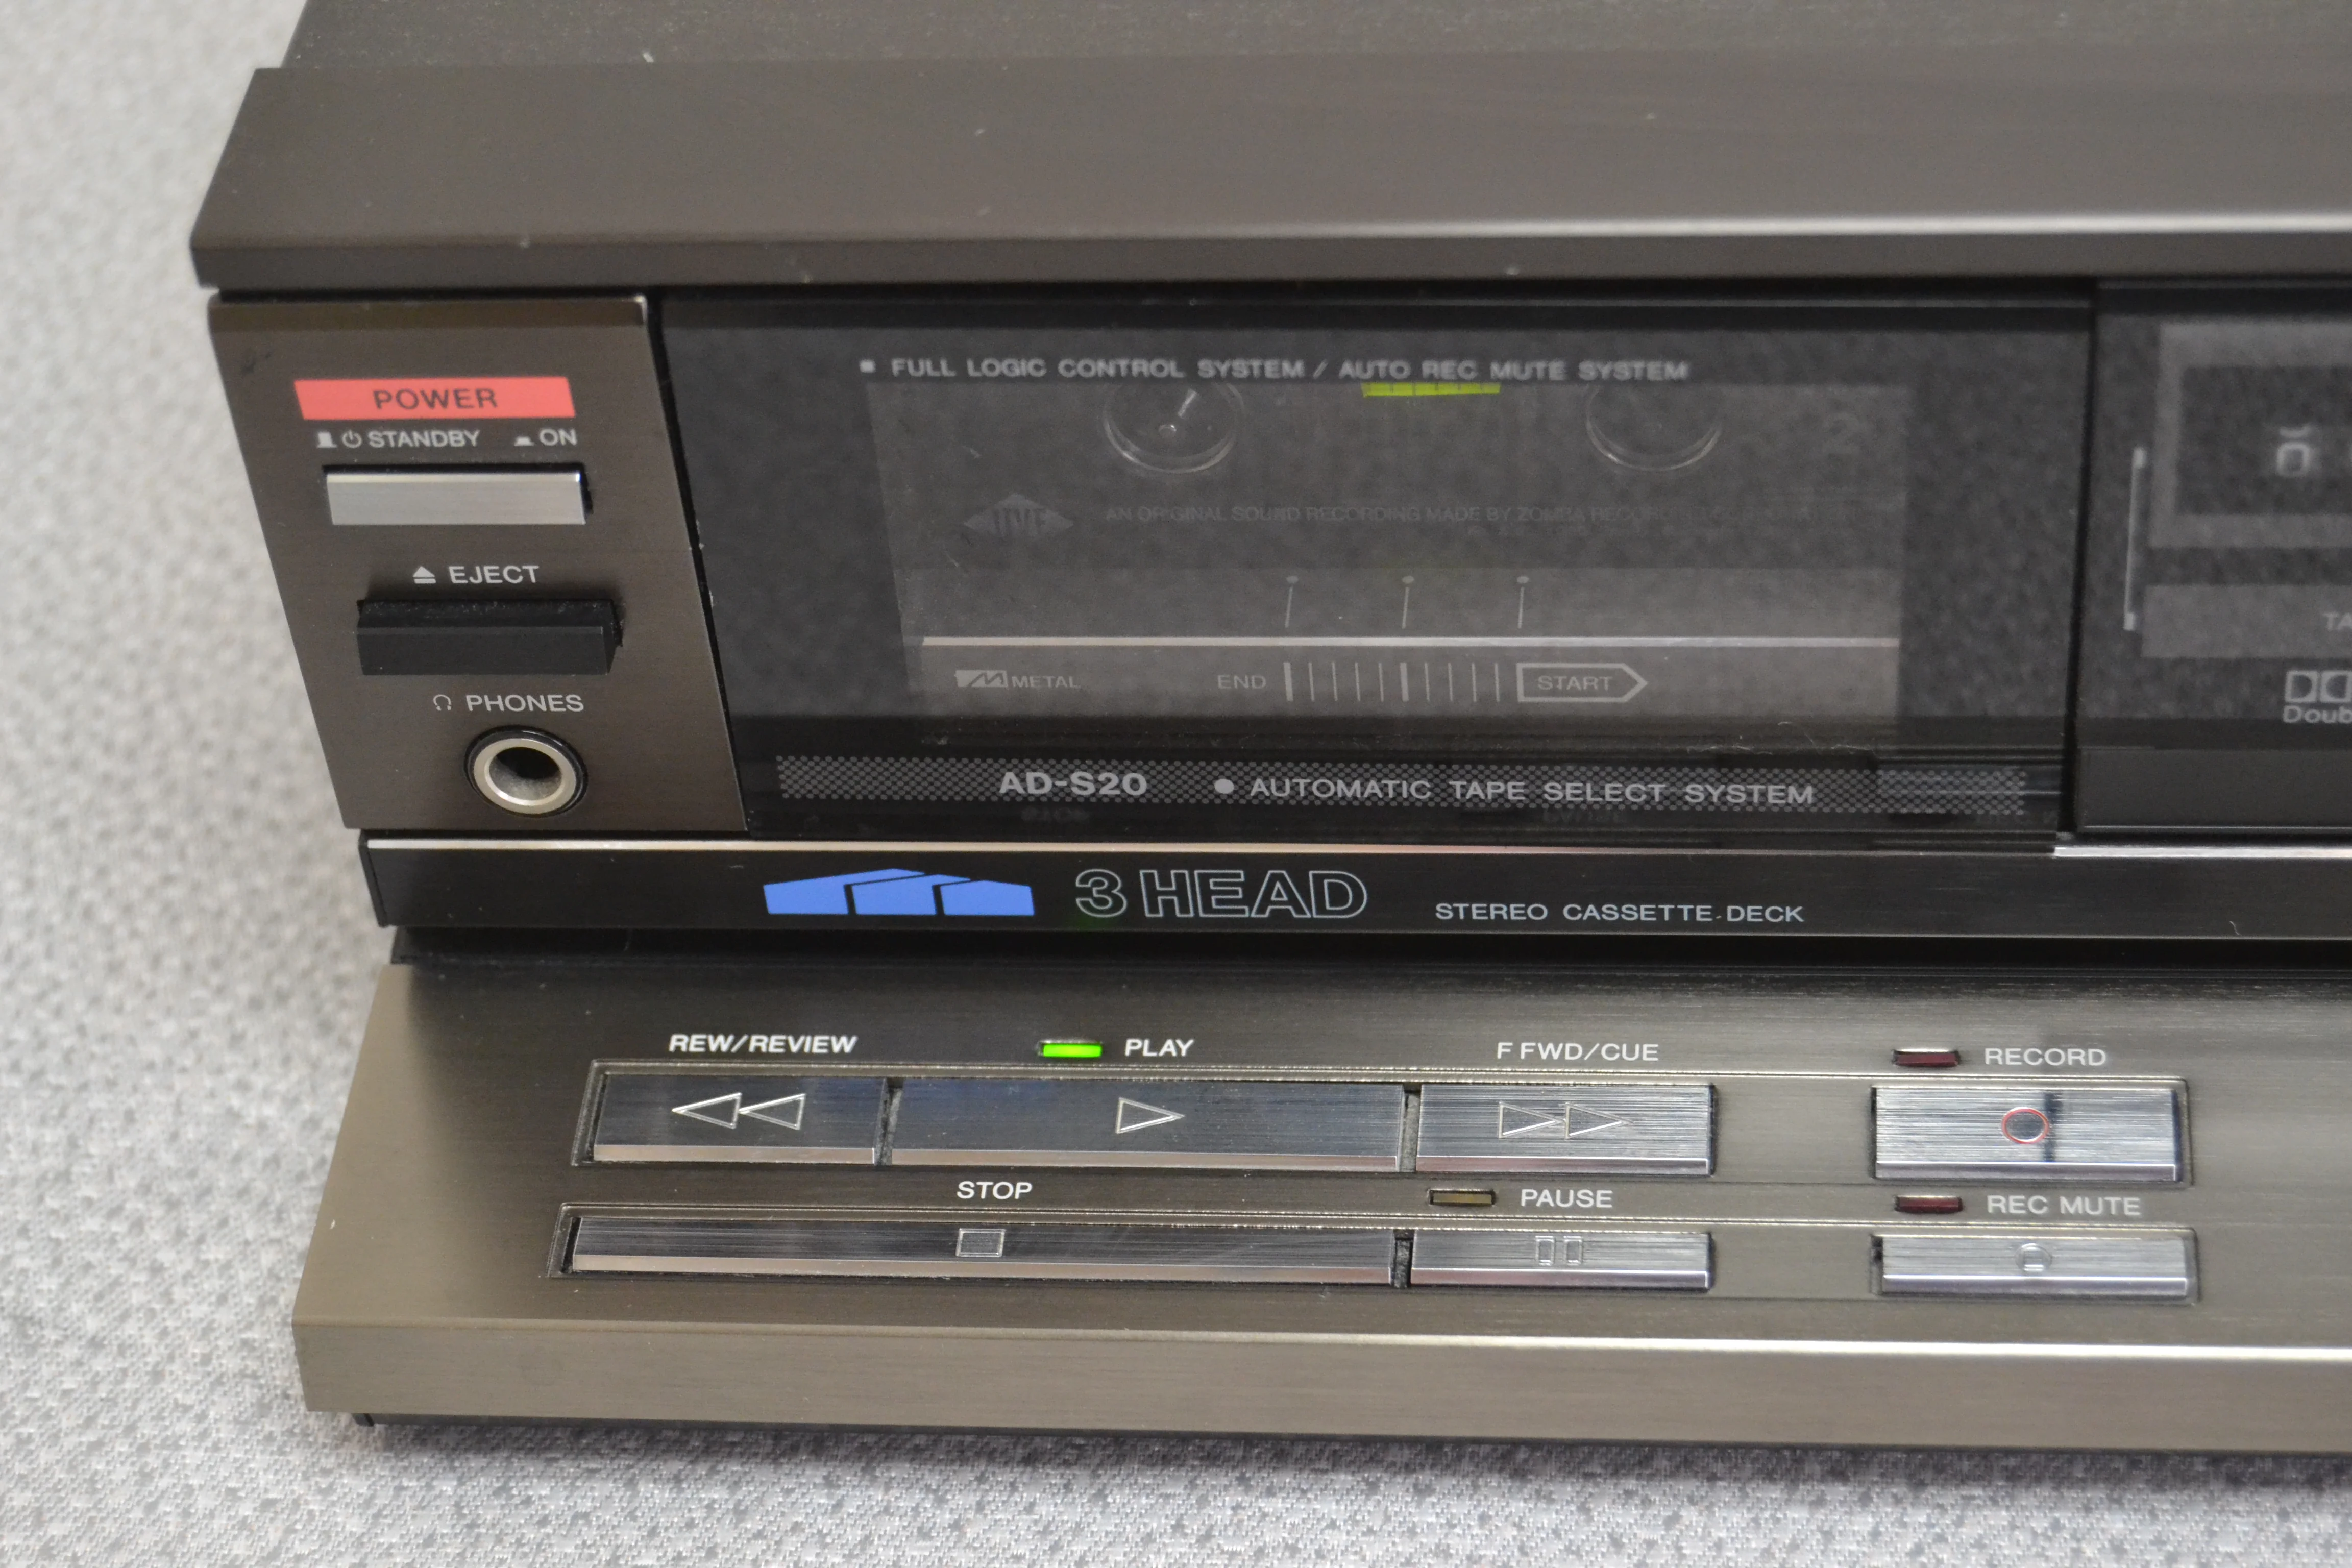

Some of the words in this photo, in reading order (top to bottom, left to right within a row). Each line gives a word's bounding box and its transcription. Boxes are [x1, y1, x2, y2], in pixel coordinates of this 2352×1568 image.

[891, 358, 955, 377] FULL
[966, 358, 1046, 377] LOGIC
[1058, 358, 1184, 378] CONTROL
[1197, 359, 1304, 379] SYSTEM
[1312, 360, 1328, 379] /
[1339, 359, 1410, 379] AUTO
[1422, 360, 1478, 380] REC
[1490, 360, 1565, 381] MUTE
[1579, 360, 1689, 381] SYSTEM
[373, 388, 498, 410] POWER
[367, 429, 480, 448] STANDBY
[538, 428, 578, 446] ON
[1231, 505, 1302, 522] SOUND
[1305, 505, 1422, 522] RECORDING
[1425, 505, 1481, 522] MADE
[1486, 505, 1512, 522] BY
[448, 565, 540, 584] EJECT
[1011, 675, 1081, 689] METAL
[1217, 674, 1267, 689] END
[1537, 675, 1611, 691] START
[465, 694, 584, 713] PHONES
[999, 770, 1148, 796] AD-S20
[1250, 777, 1432, 800] AUTOMATIC
[1448, 780, 1526, 801] TAPE
[1543, 781, 1667, 803] SELECT
[1682, 782, 1815, 804] SYSTEM
[1074, 868, 1128, 918] 3
[1139, 869, 1368, 919] HEAD
[1435, 902, 1549, 921] STEREO
[1562, 903, 1713, 922] CASSETTE
[1726, 905, 1804, 923] DECK
[669, 1034, 857, 1054] REW/REVIEW
[1124, 1038, 1194, 1057] PLAY
[1497, 1041, 1513, 1059] F
[1520, 1042, 1659, 1062] FWD/CUE
[1984, 1047, 2107, 1067] RECORD
[956, 1180, 1033, 1200] STOP
[1521, 1188, 1613, 1209] PAUSE
[1987, 1194, 2048, 1215] REC
[2060, 1196, 2141, 1216] MUTE
